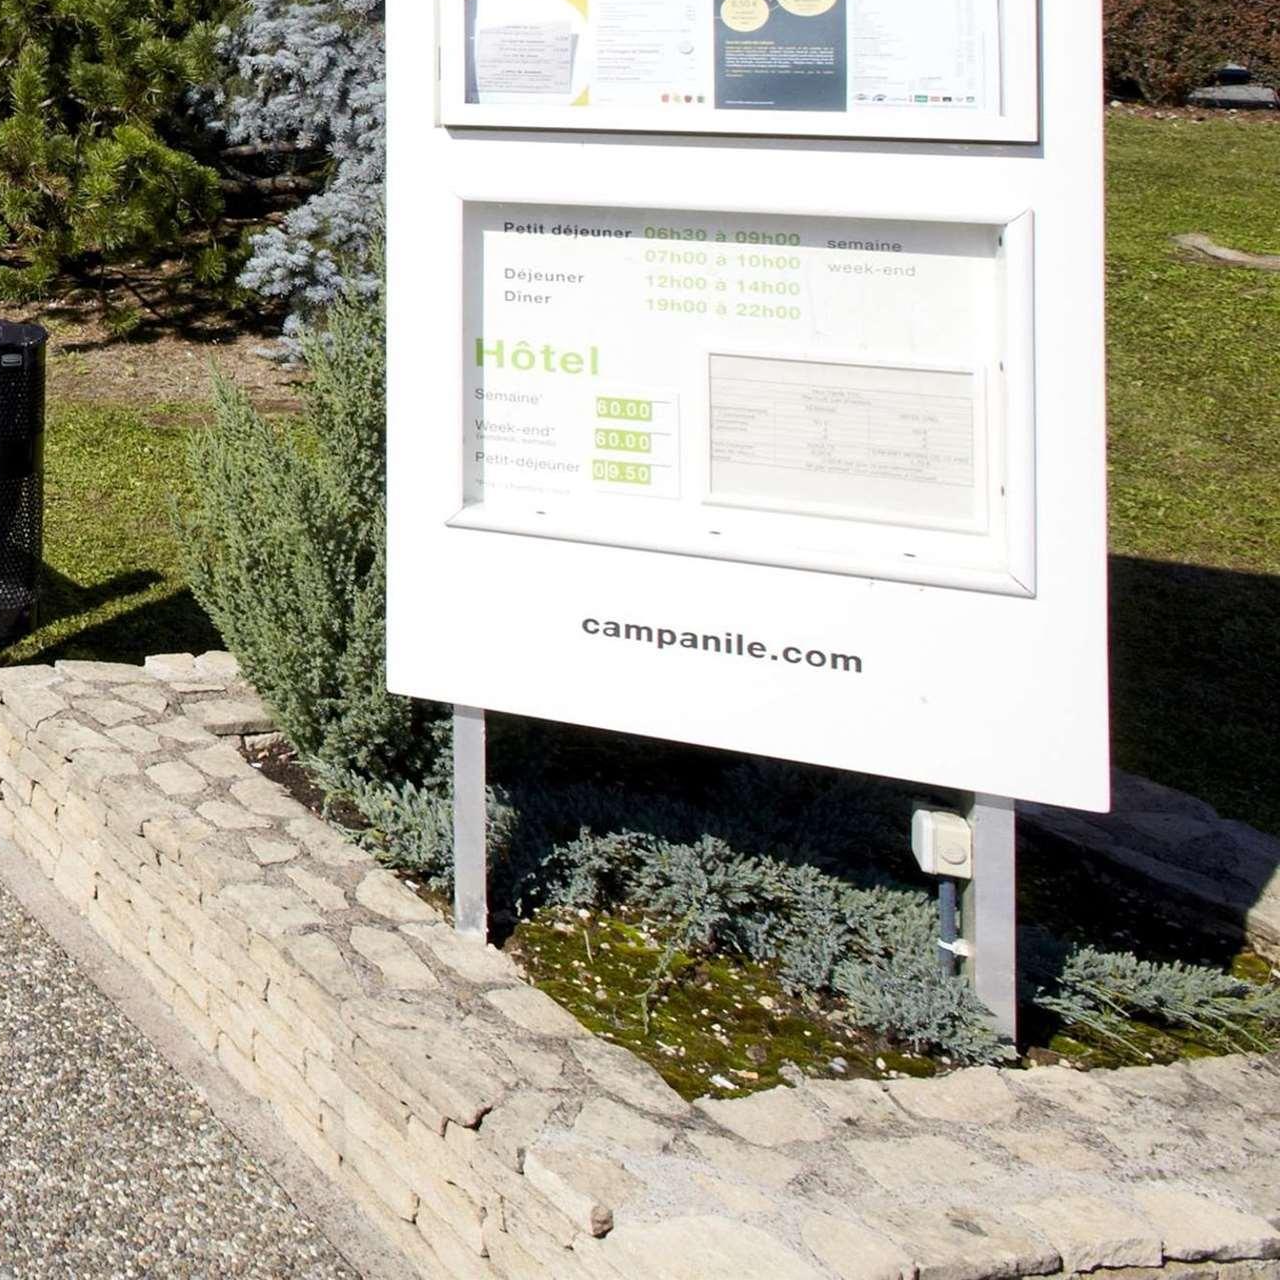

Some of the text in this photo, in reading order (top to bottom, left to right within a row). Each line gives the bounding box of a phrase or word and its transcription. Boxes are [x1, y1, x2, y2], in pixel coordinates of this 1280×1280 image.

[503, 221, 801, 246] Petit déjeuner 06h30 à 09h00
[826, 239, 903, 253] semaine
[643, 249, 708, 266] 07h00
[736, 253, 801, 270] 10h00
[827, 263, 917, 277] week-end
[503, 268, 584, 285] Déjeuner
[645, 274, 707, 290] 12h00
[737, 279, 801, 296] 14h00
[503, 289, 552, 305] Dîner
[645, 298, 708, 314] 19h00
[734, 303, 801, 320] 22h00
[474, 337, 600, 376] Hôtel
[474, 451, 581, 473] Petit-déjeuner
[581, 614, 865, 675] campanile.com
